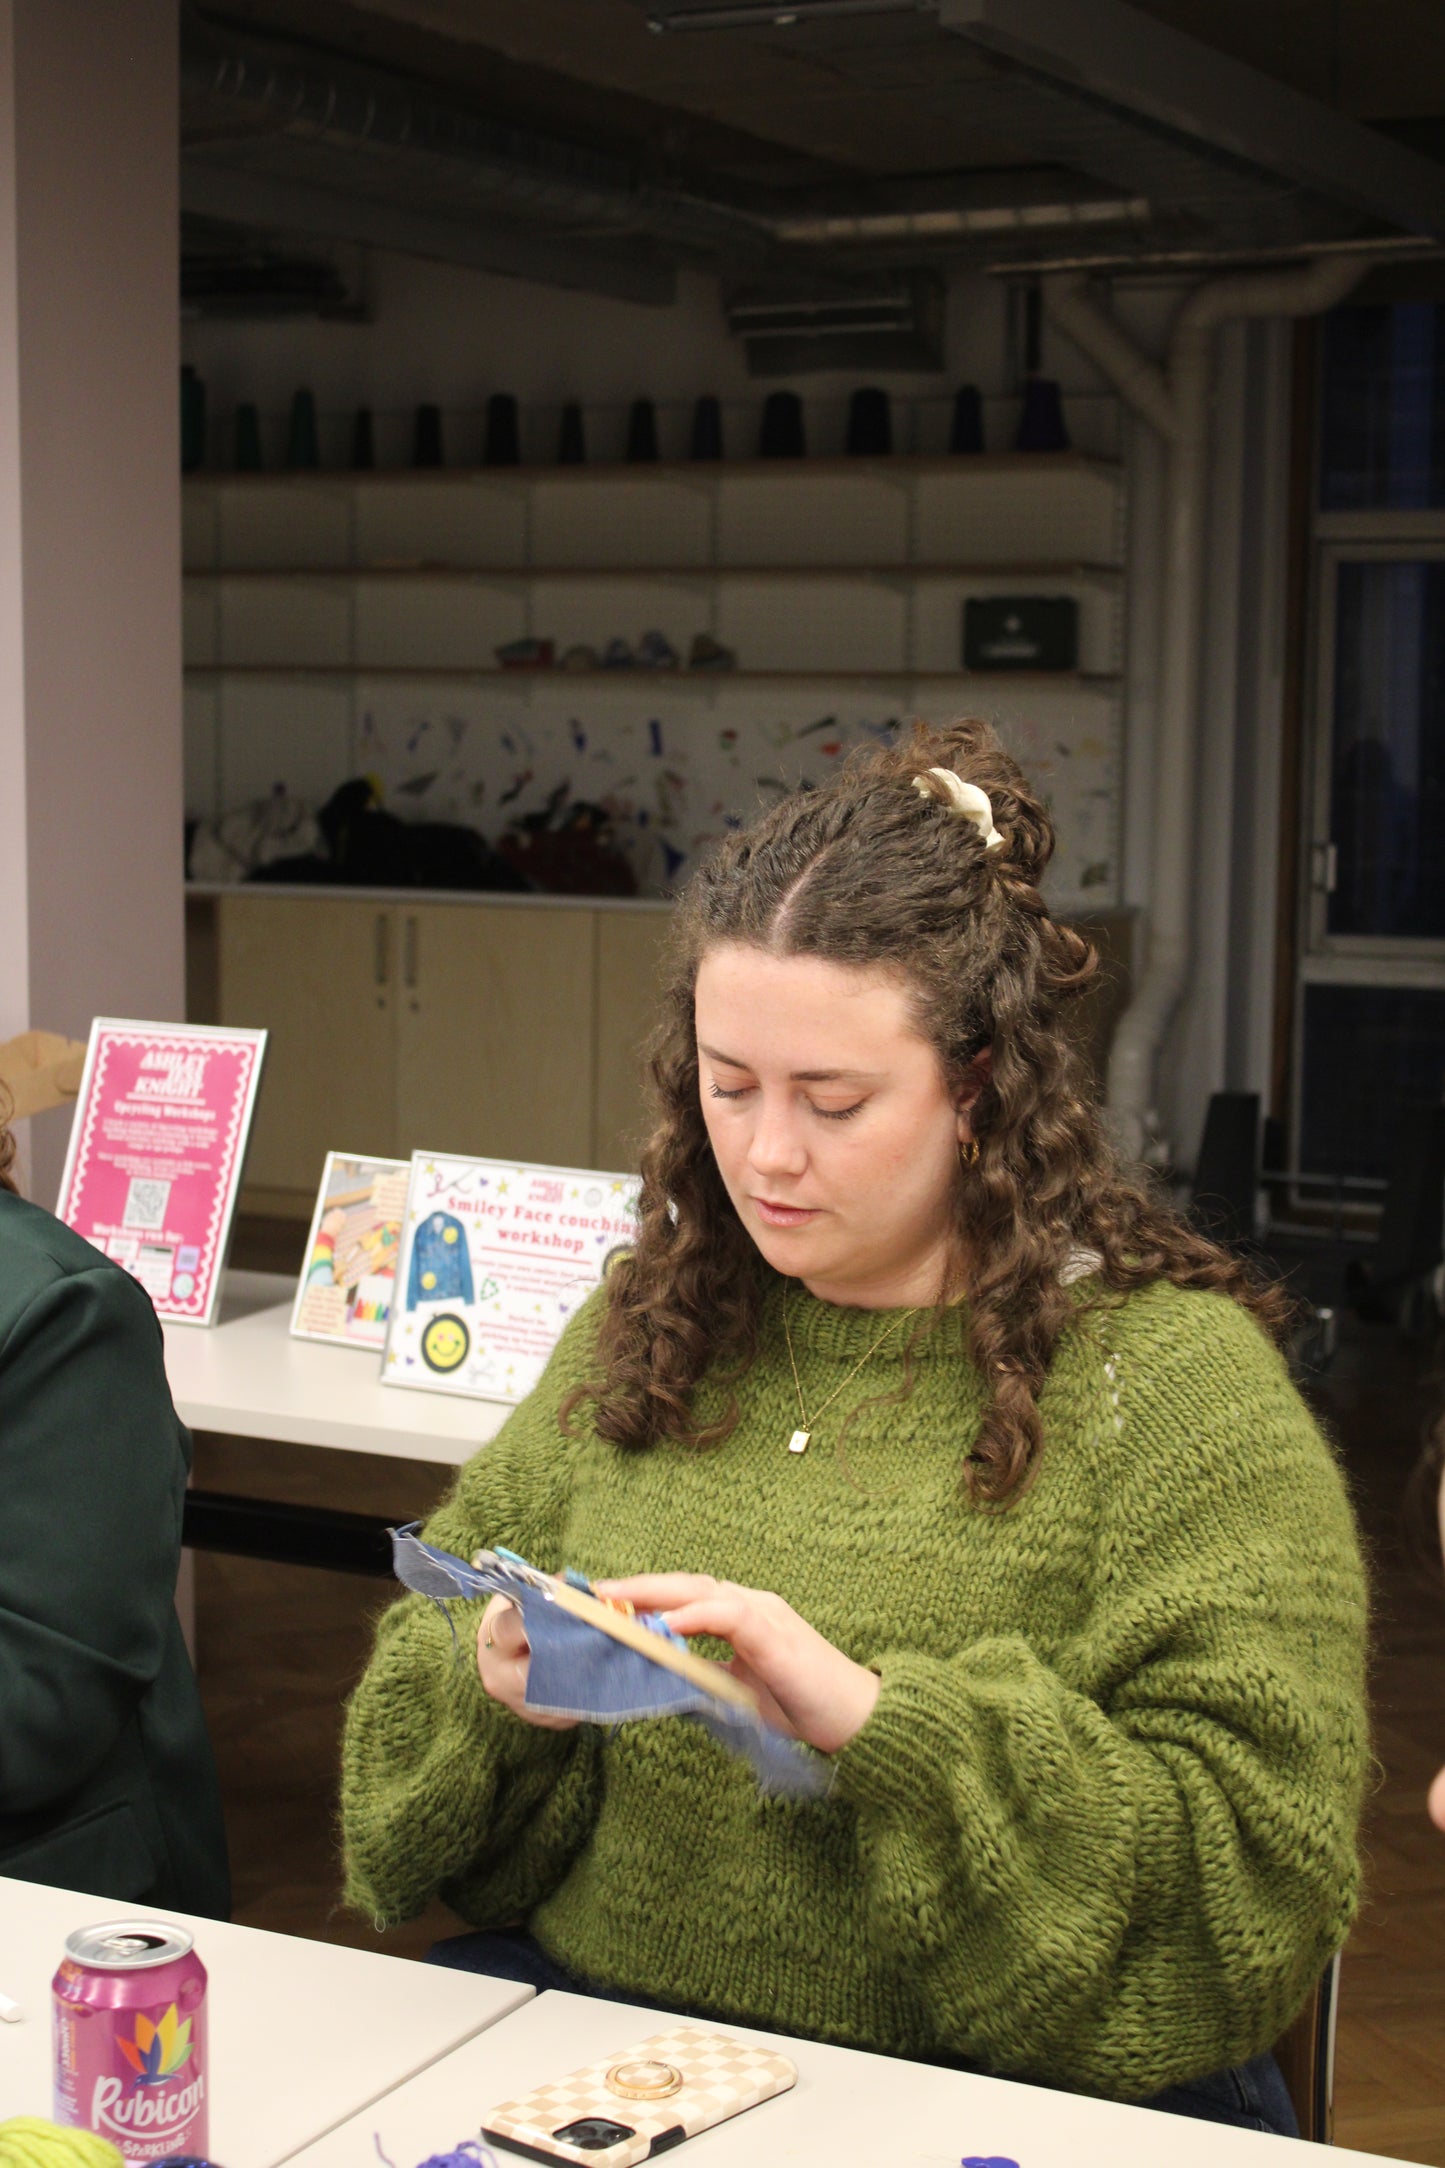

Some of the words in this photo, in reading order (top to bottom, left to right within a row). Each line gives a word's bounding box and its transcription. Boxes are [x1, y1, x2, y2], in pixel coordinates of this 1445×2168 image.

[448, 1197, 507, 1218] Smiley
[513, 1204, 553, 1224] Face
[497, 1227, 584, 1254] workshop
[91, 2074, 204, 2132] Rubicon
[122, 2131, 185, 2158] SPARKLING
